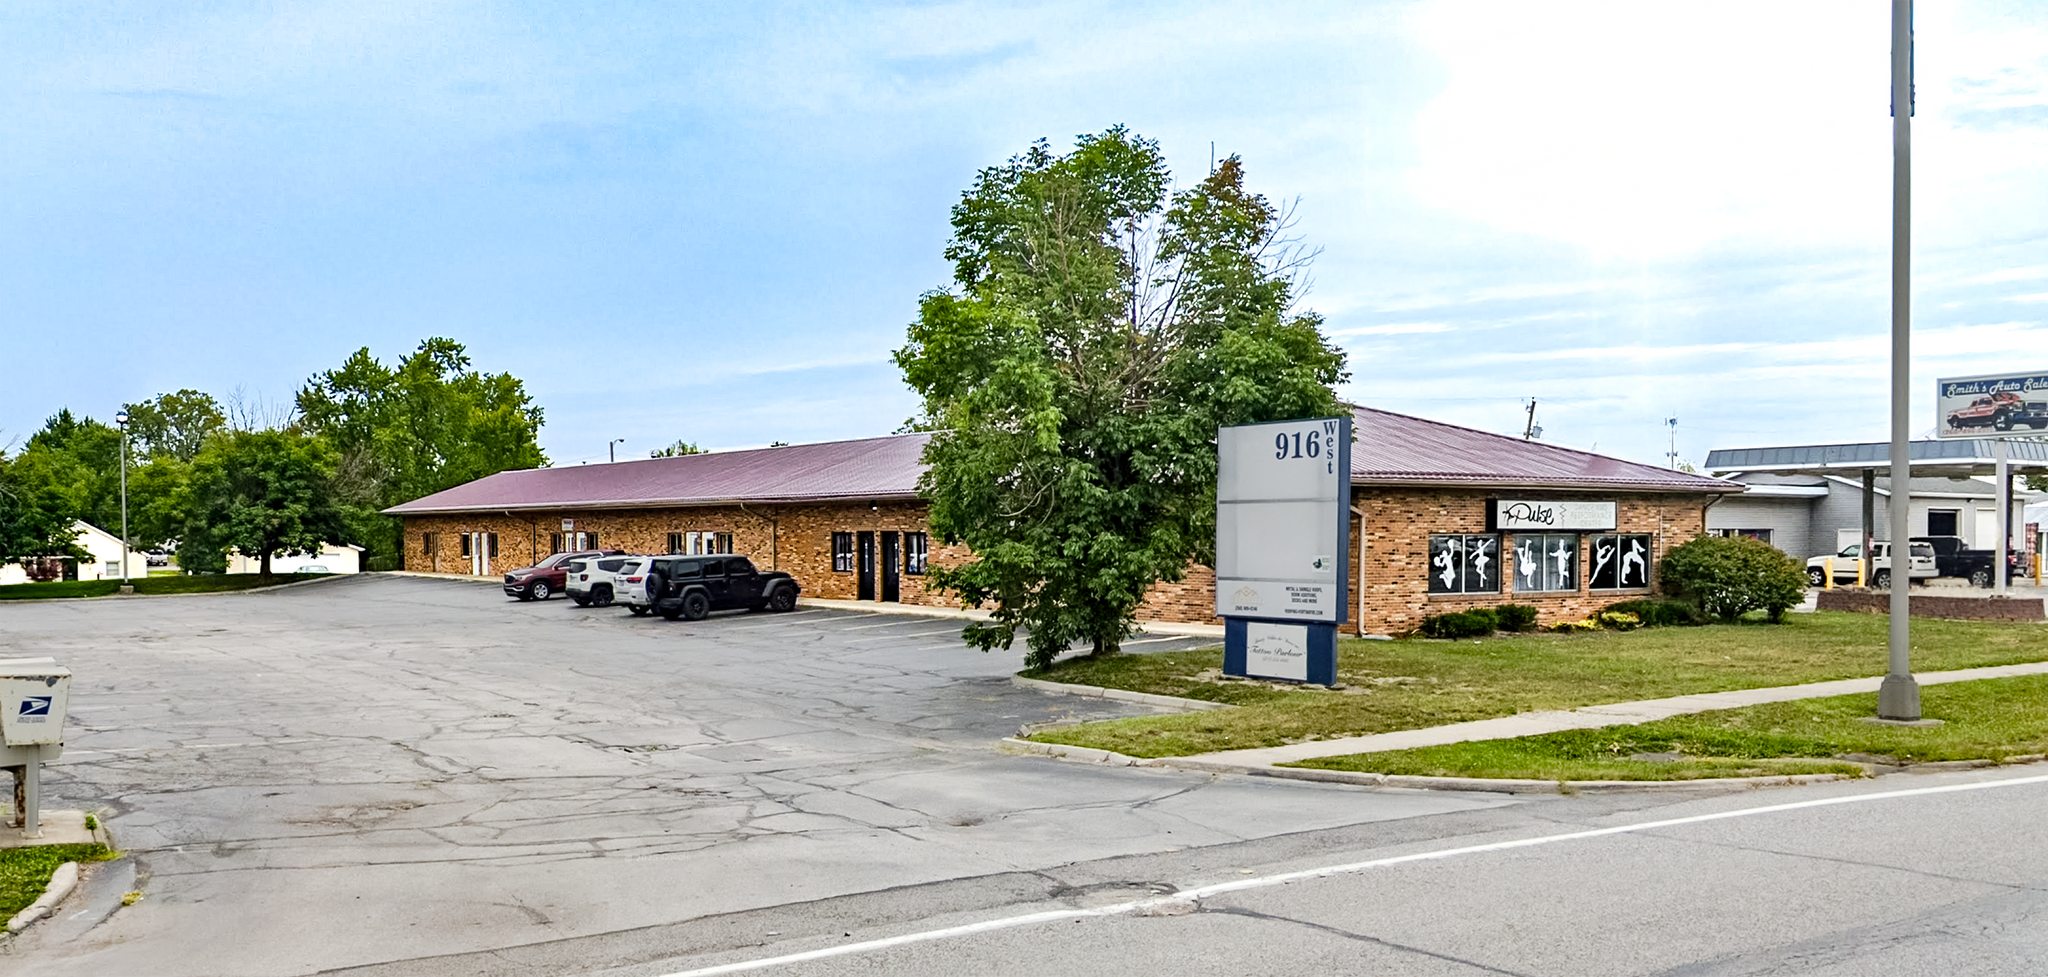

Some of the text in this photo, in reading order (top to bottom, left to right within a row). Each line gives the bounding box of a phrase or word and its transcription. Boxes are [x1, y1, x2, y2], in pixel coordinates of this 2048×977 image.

[1947, 382, 1987, 397] Smith's
[1989, 380, 2020, 395] Auto
[1275, 430, 1320, 460] 916
[1323, 421, 1337, 474] West
